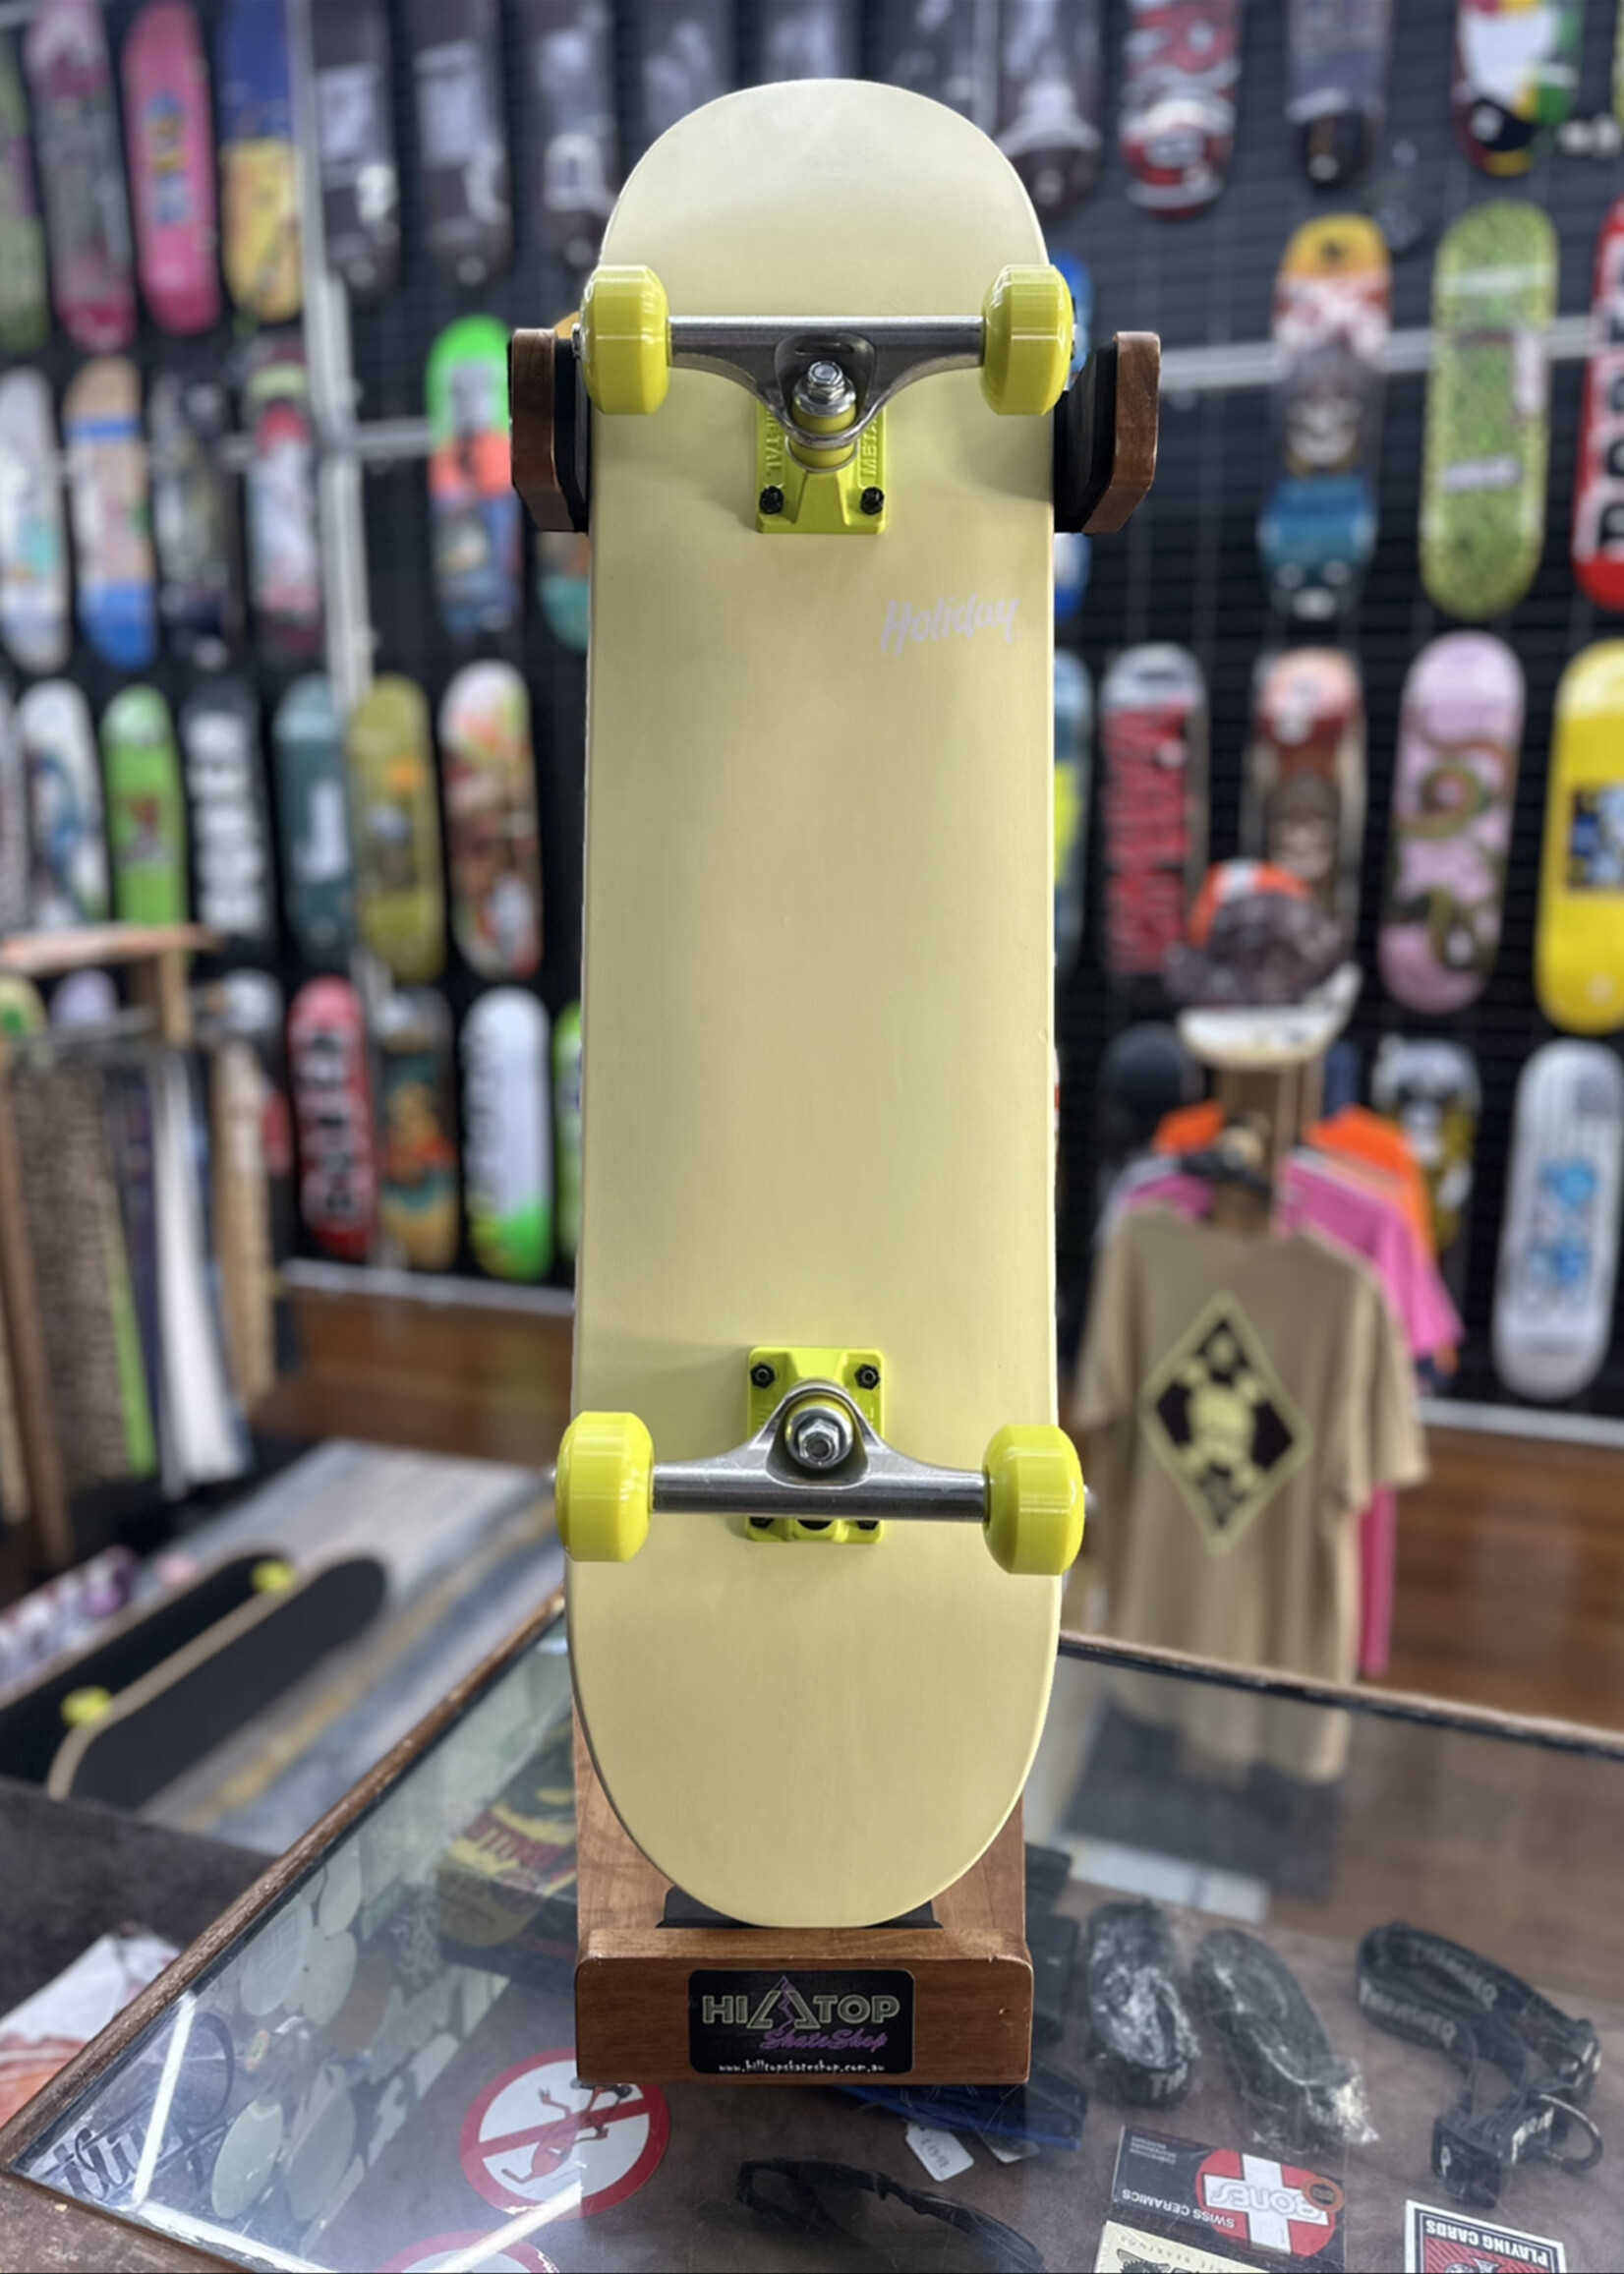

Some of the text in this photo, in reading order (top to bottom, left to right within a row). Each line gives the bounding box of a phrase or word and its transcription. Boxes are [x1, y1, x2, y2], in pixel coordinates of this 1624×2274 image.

[879, 592, 1022, 656] Holiday
[1121, 2188, 1235, 2229] SWISS CERAMICS
[1210, 2183, 1320, 2220] BONES
[1424, 2219, 1548, 2265] PLAYING CARDS
